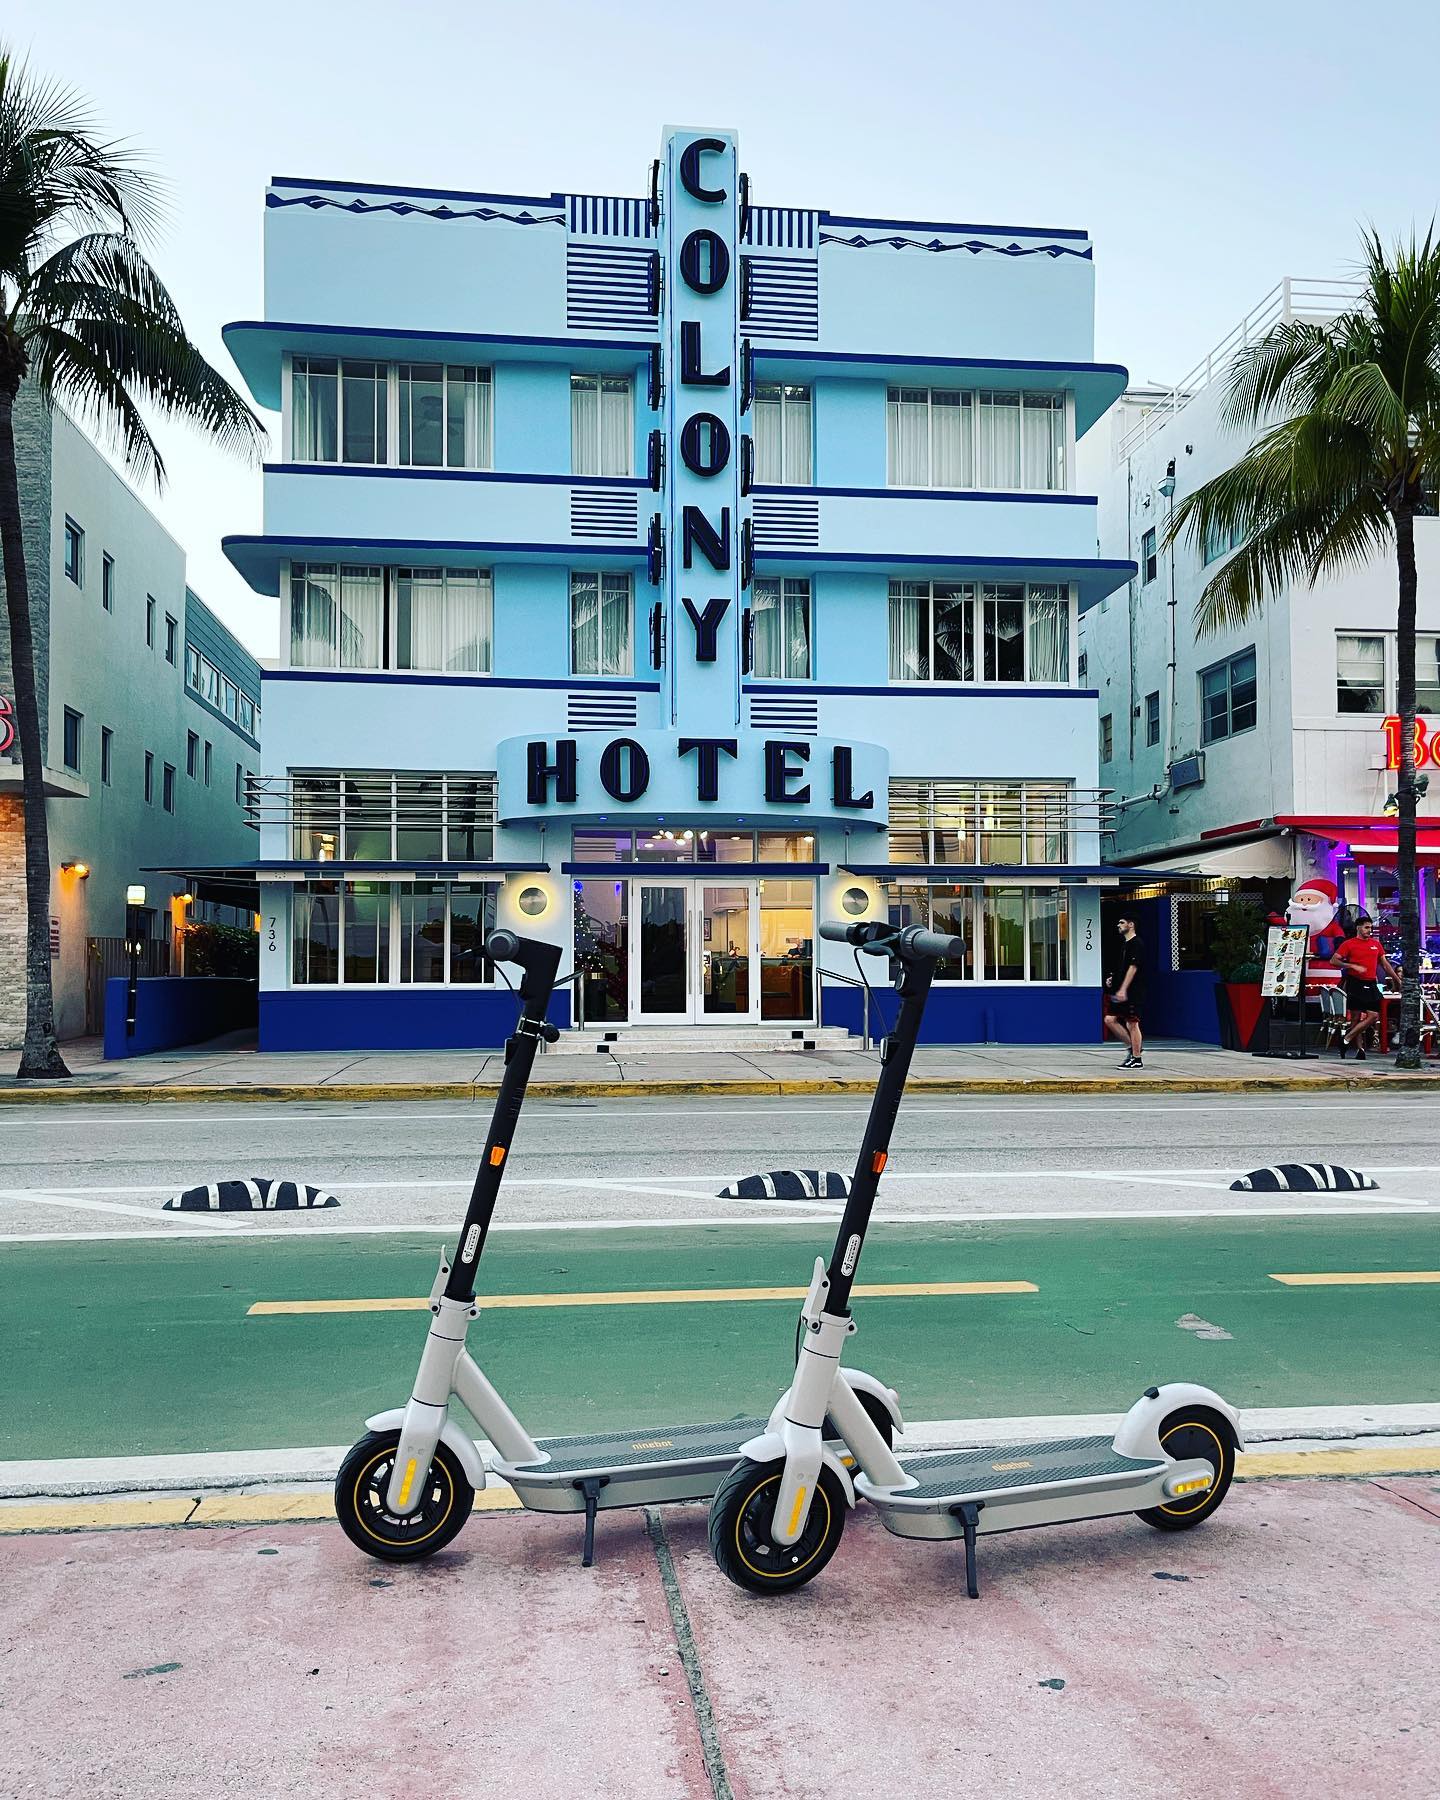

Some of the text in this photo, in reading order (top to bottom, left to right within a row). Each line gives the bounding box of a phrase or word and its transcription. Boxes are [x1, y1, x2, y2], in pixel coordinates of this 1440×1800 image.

[680, 138, 731, 663] COLONY
[527, 737, 874, 809] HOTEL
[268, 917, 276, 951] 736
[1085, 918, 1093, 951] 736
[632, 1440, 674, 1450] ninebot
